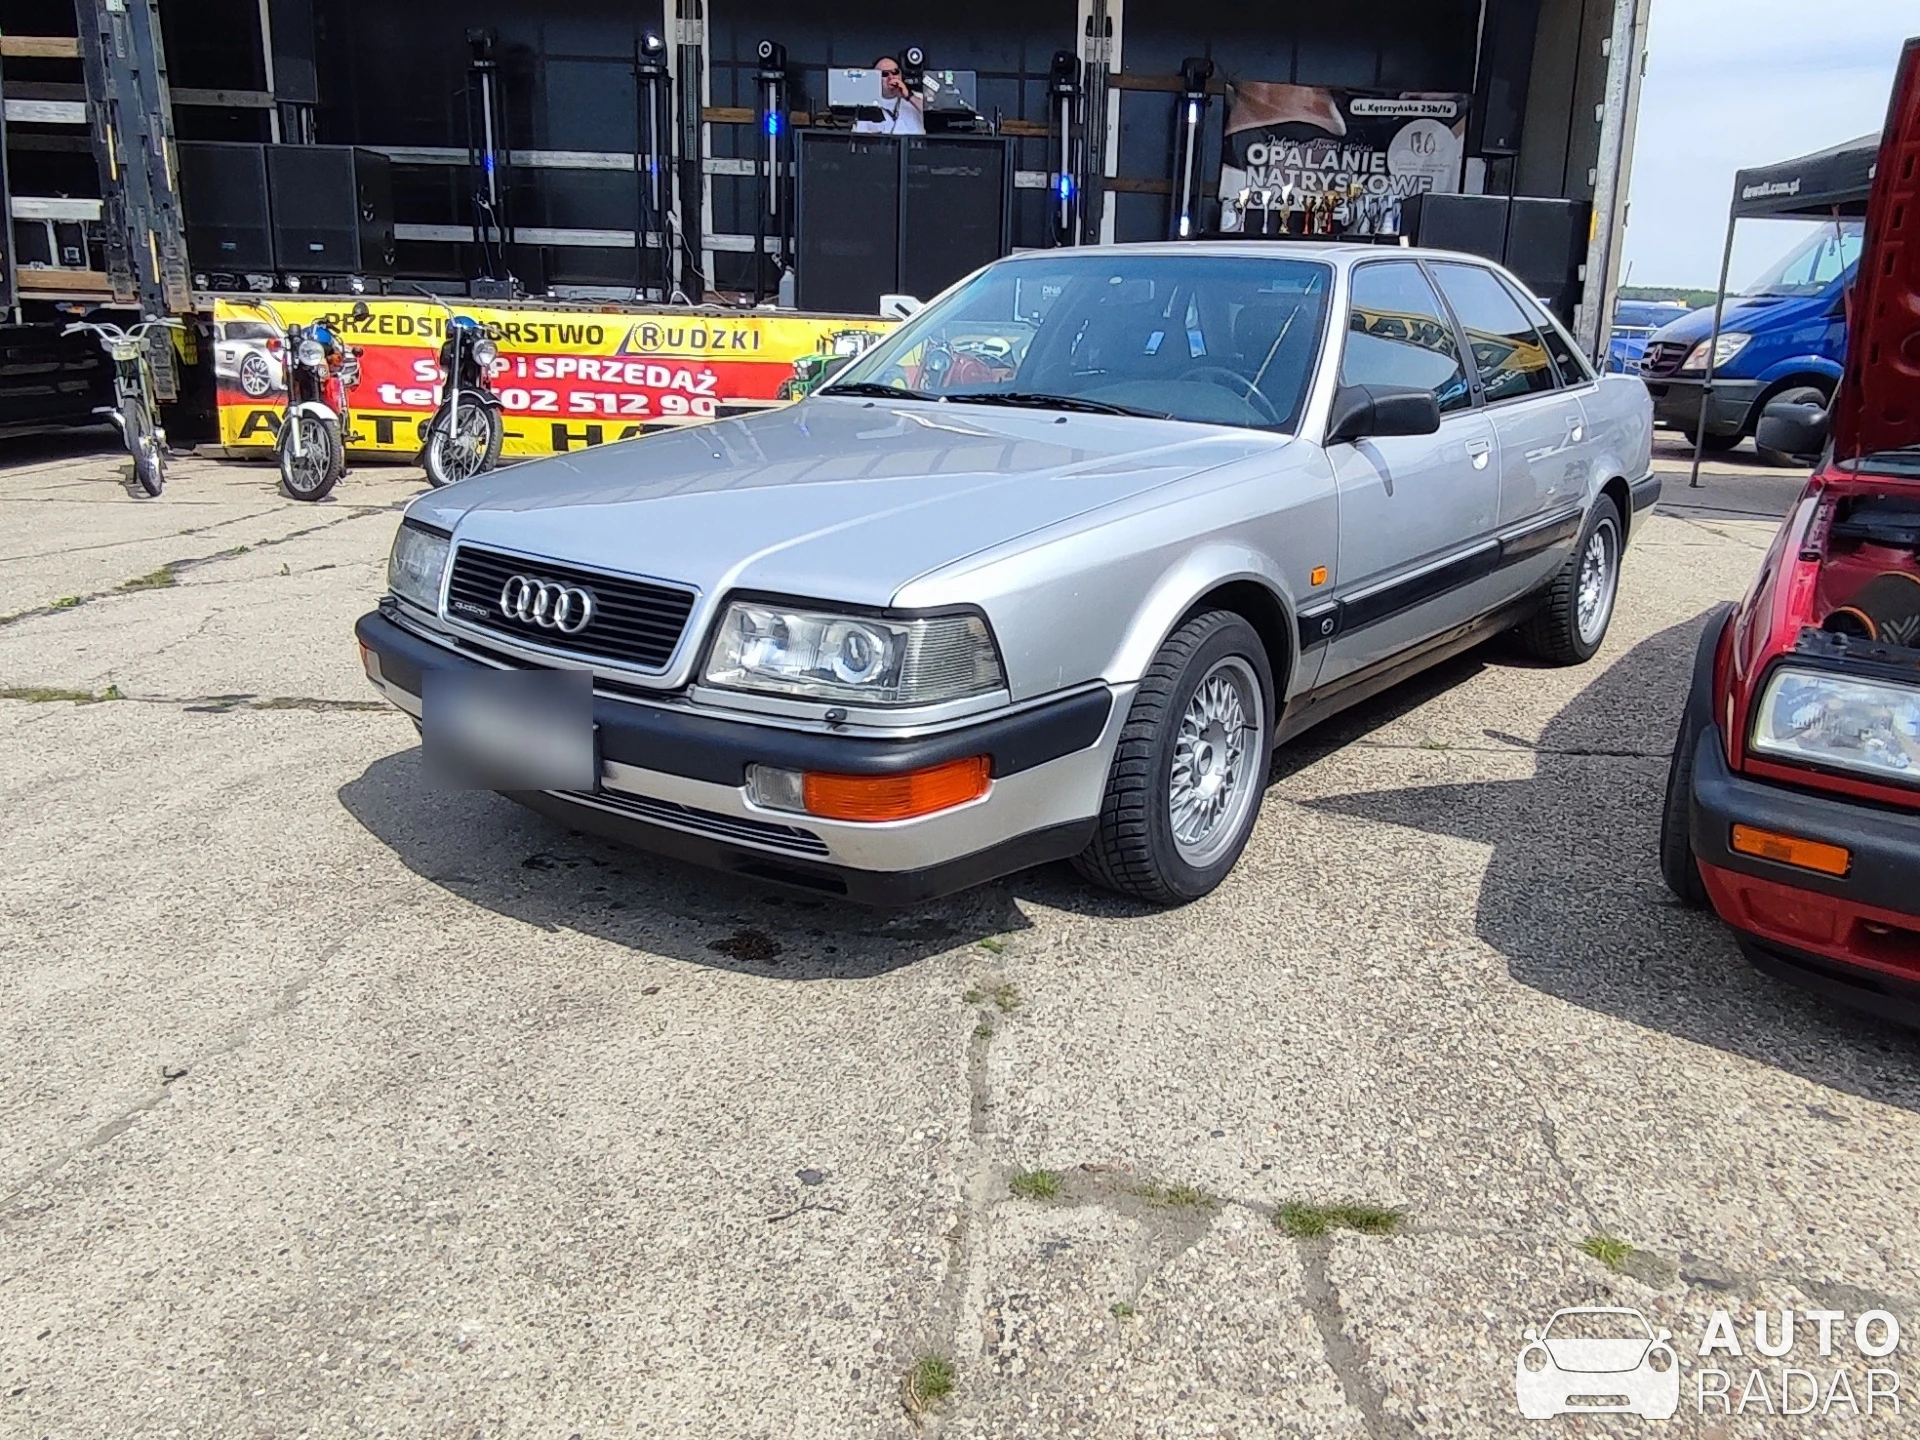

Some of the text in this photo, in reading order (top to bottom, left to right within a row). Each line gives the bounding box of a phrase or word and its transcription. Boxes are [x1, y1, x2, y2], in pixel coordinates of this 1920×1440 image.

[1354, 103, 1366, 112] ul.
[1247, 142, 1386, 173] OPALANIE
[1246, 166, 1434, 198] NATRYSKOWE
[634, 323, 760, 350] RUDZKI
[517, 356, 527, 378] i
[534, 358, 718, 397] SPRZEDAŻ
[568, 391, 650, 415] 512
